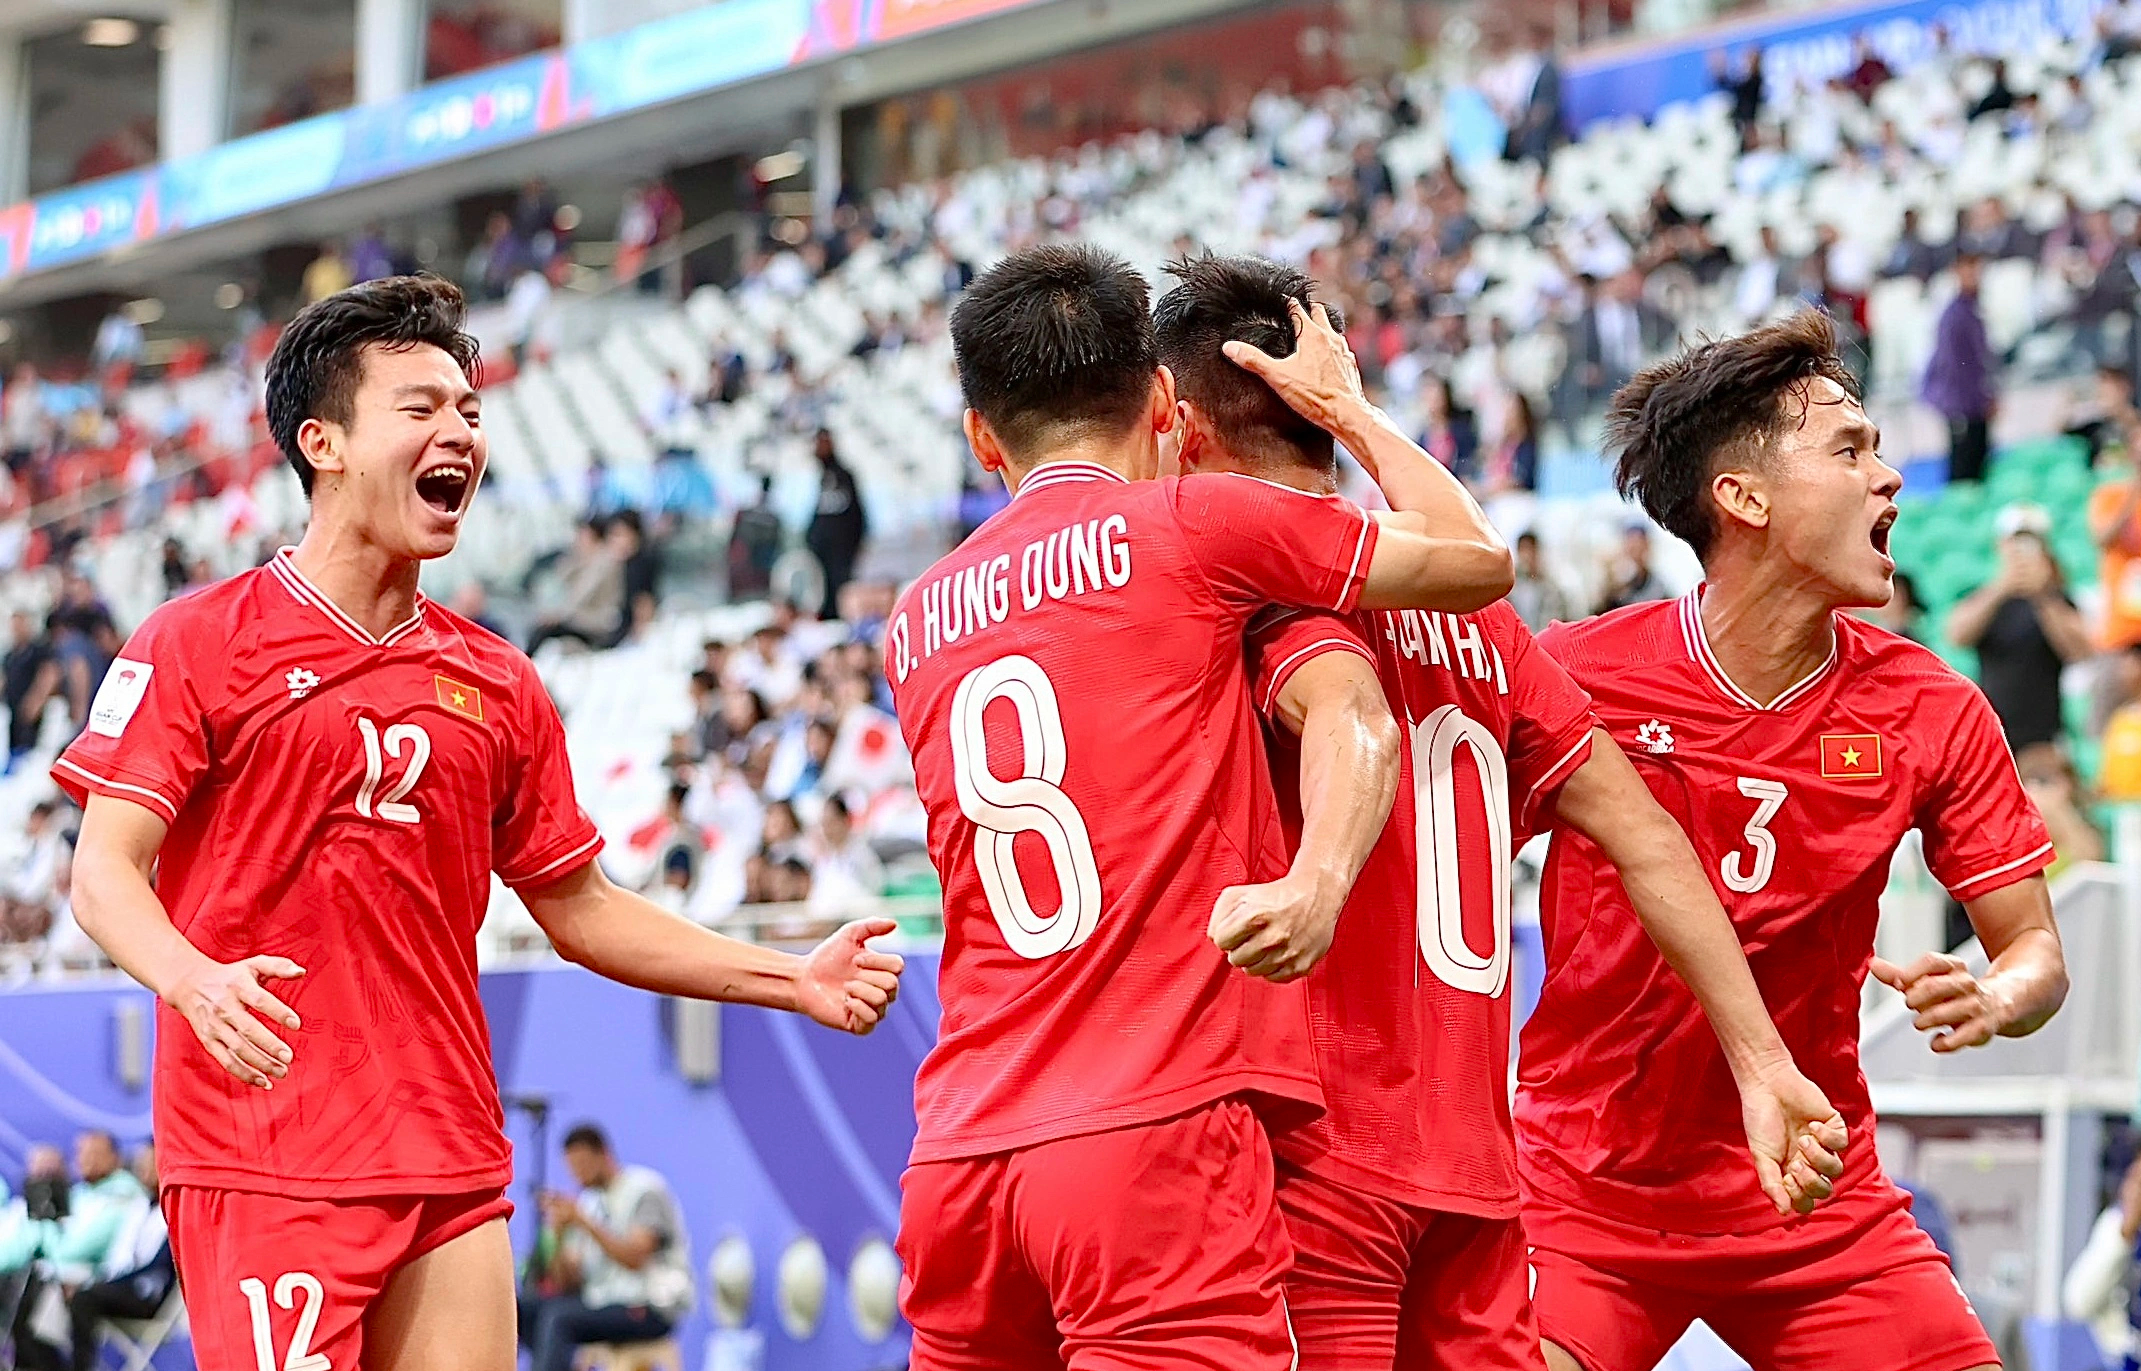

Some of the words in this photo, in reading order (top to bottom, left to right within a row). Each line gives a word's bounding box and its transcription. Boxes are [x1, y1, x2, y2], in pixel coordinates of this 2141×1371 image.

[891, 611, 919, 686] D.
[922, 553, 1011, 658] HUNG
[1019, 513, 1133, 612] DUNG
[356, 716, 431, 824] 12
[949, 654, 1103, 960] 8
[1721, 776, 1789, 894] 3
[1404, 703, 1512, 999] 0
[239, 1271, 332, 1371] 12
